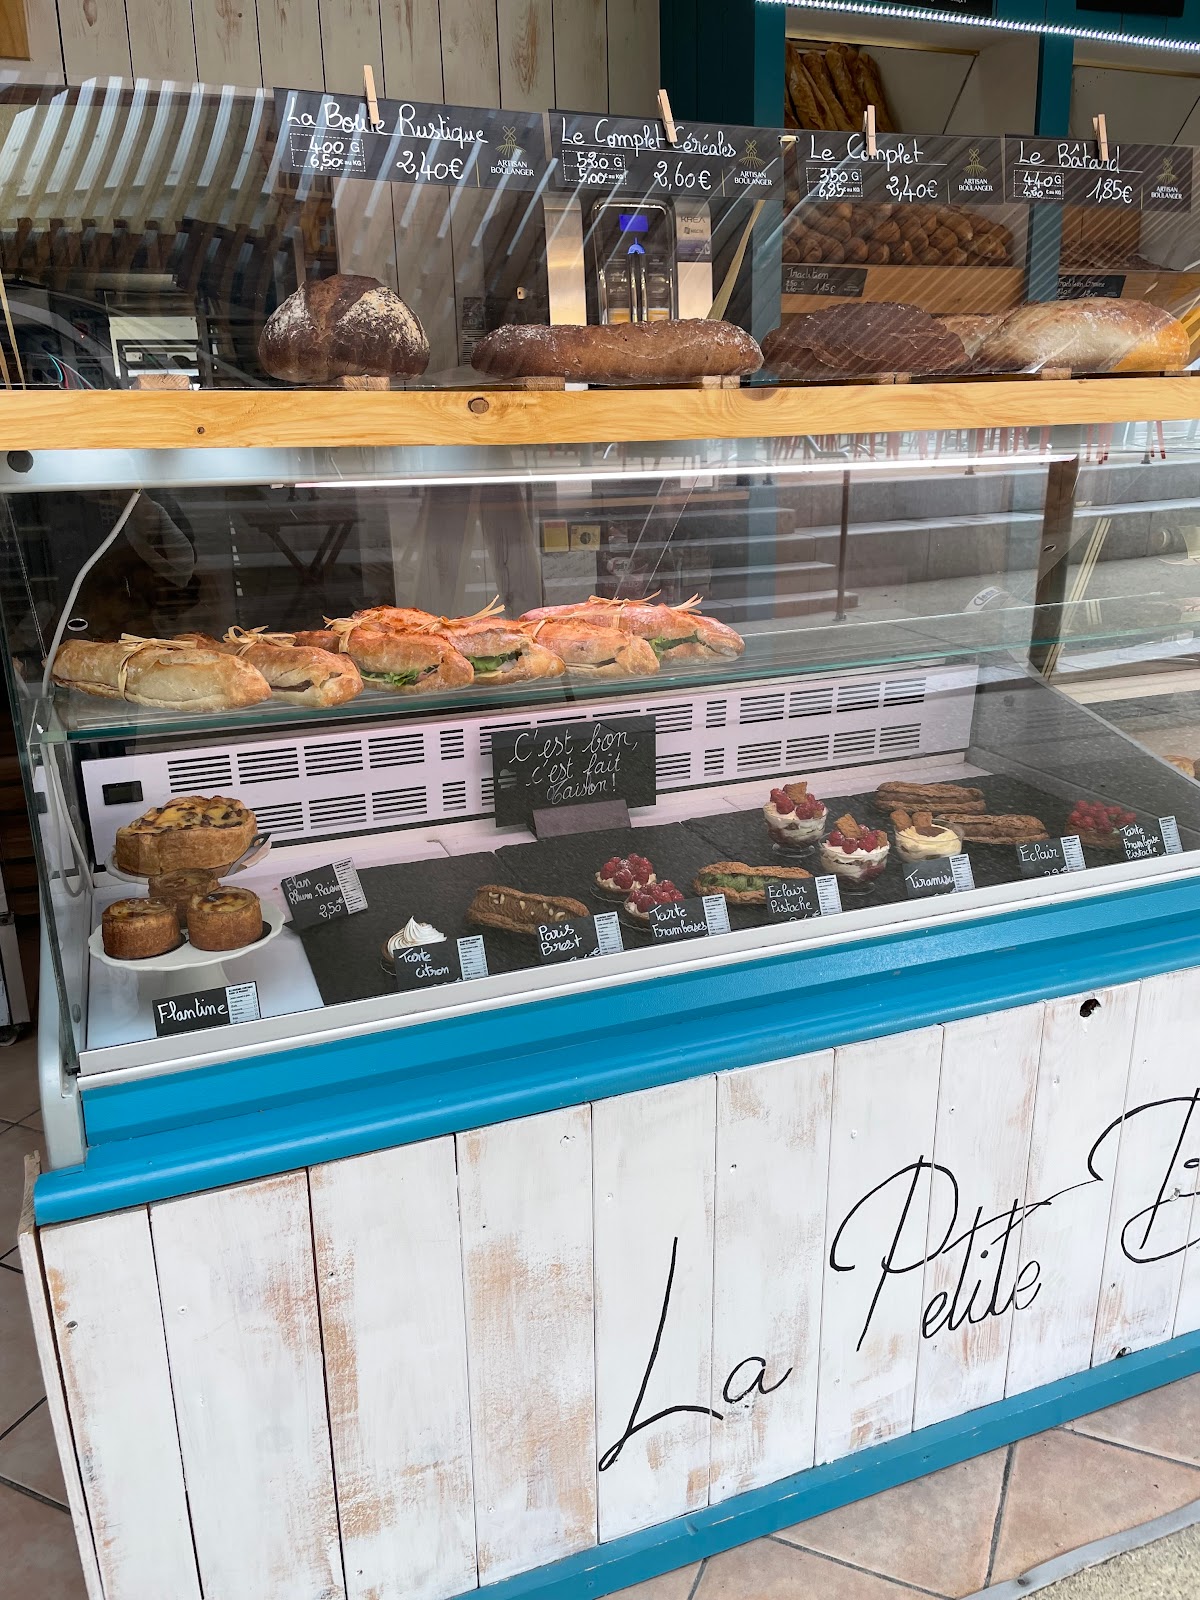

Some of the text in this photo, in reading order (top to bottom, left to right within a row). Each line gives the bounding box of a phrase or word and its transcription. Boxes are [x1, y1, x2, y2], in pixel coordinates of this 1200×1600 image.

[287, 97, 486, 149] La Boue Rustique
[310, 136, 360, 154] 400 G
[562, 117, 584, 144] Le
[595, 119, 664, 157] Complet
[810, 135, 835, 161] Le
[1019, 141, 1045, 165] Le
[396, 151, 464, 180] 2,40€
[497, 159, 528, 168] ARTISAN
[577, 151, 622, 169] 520 G
[490, 166, 535, 176] BOULANGER
[653, 160, 712, 192] 2,60€
[740, 170, 767, 179] ARTISAN
[819, 167, 859, 184] 350 G
[1023, 170, 1062, 189] 440 G
[734, 177, 773, 186] BOULANGER
[886, 175, 938, 202] 2,40€
[958, 184, 993, 192] BOULANGER
[1086, 177, 1133, 204] 1,85€
[1151, 192, 1183, 200] BOULANGER
[509, 723, 638, 764] C'est bon,
[582, 752, 620, 780] fait
[1120, 824, 1145, 837] Tarte
[1019, 844, 1059, 862] Eclair
[1125, 846, 1158, 859] Pistache
[285, 876, 311, 891] Flan
[768, 883, 807, 898] Eclair
[650, 903, 687, 921] Tarte
[770, 896, 813, 913] Pistache
[538, 924, 574, 941] Paris
[652, 920, 708, 937] Framboises
[540, 934, 582, 956] Brest
[398, 948, 432, 963] Tarte
[157, 998, 228, 1024] Flantine
[598, 1236, 793, 1472] La
[830, 1155, 1052, 1352] Petite
